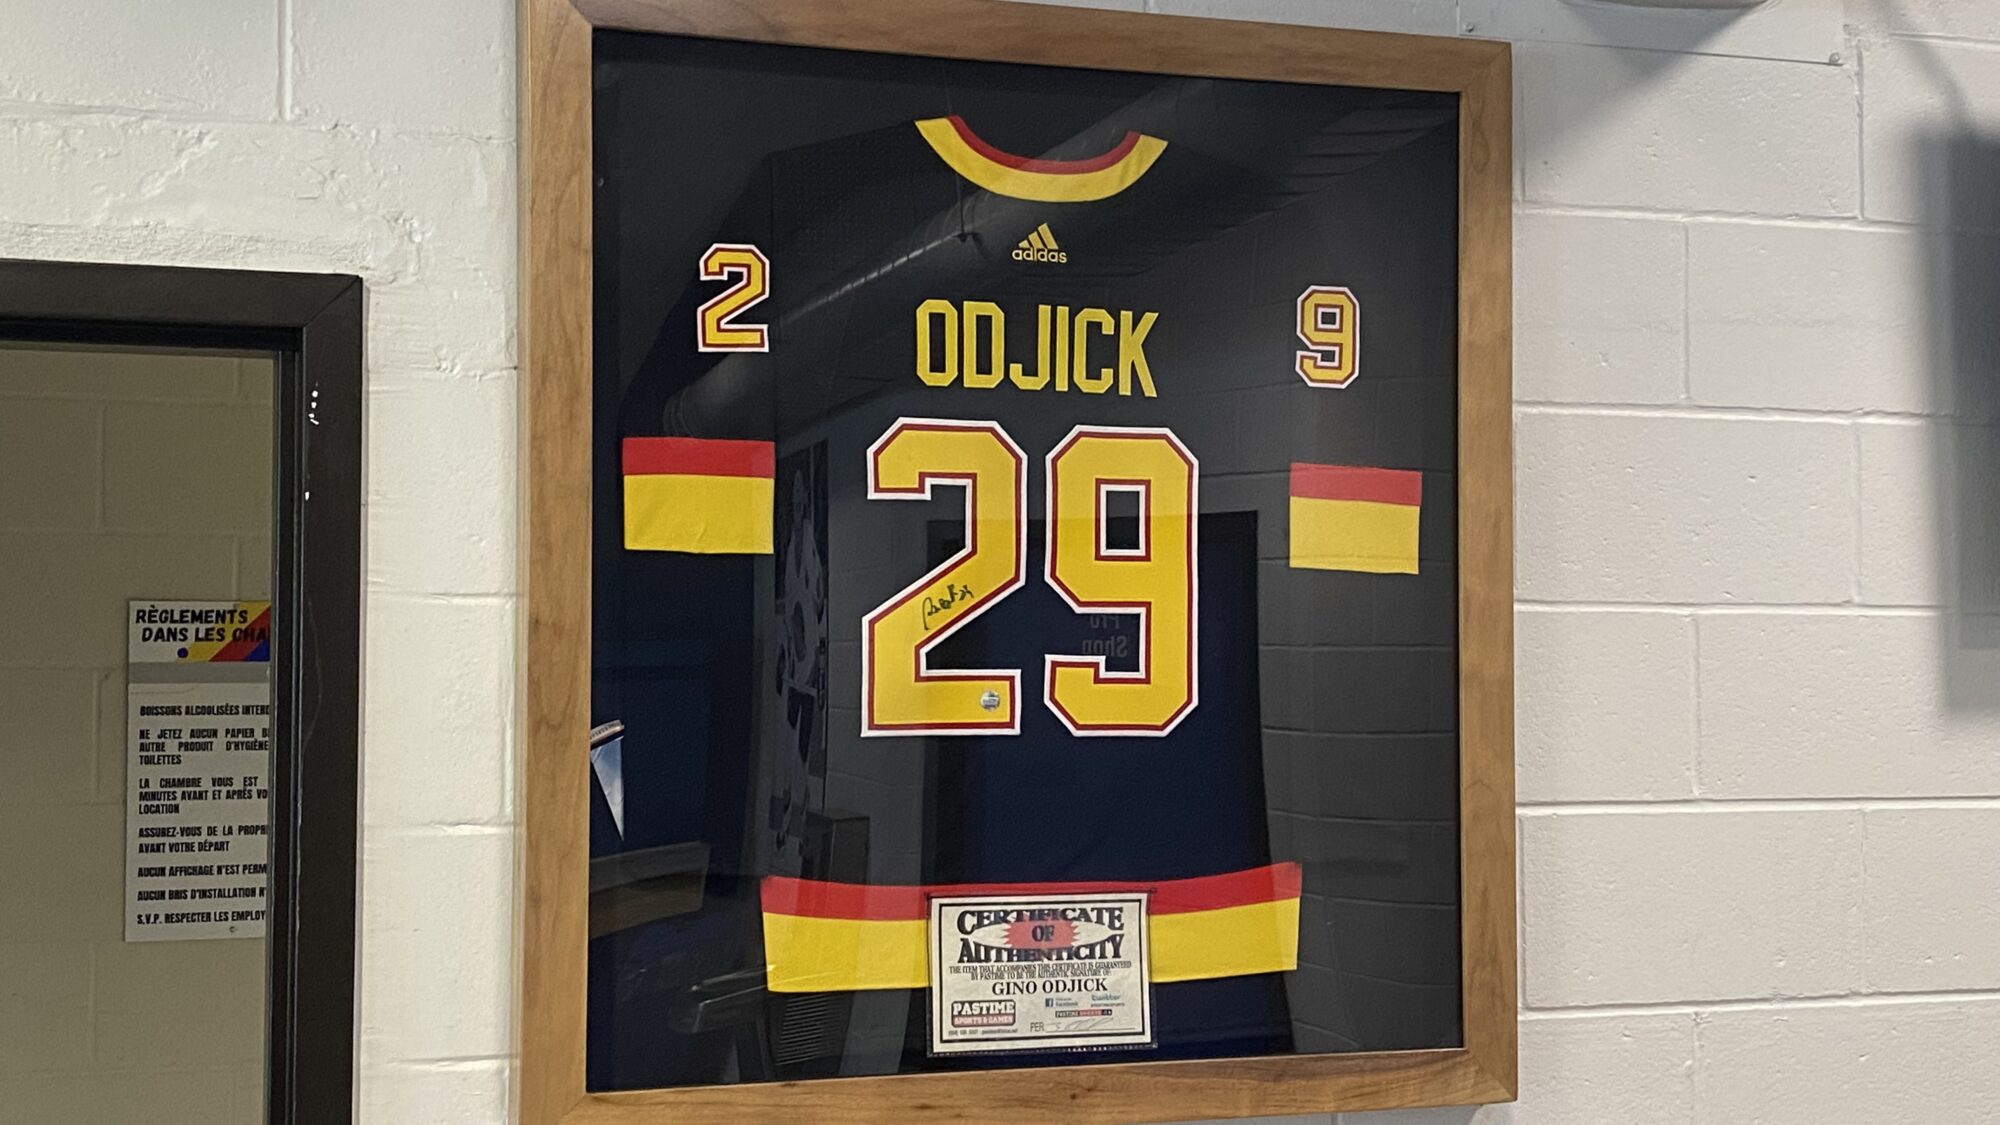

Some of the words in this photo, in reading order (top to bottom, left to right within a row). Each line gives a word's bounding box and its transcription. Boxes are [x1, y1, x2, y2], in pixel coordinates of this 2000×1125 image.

[1012, 247, 1068, 263] adidas
[697, 243, 770, 352] 2
[1295, 286, 1360, 389] 9
[916, 299, 1159, 398] ODJICK
[860, 417, 1198, 737] 29
[136, 605, 248, 624] RÈGLEMENTS
[142, 628, 188, 642] DANS
[195, 628, 225, 642] LES
[140, 706, 183, 716] BOISSONS
[184, 703, 239, 715] ALCOOLISÉES
[139, 729, 150, 740] NE
[157, 729, 182, 739] JETEZ
[190, 729, 218, 739] AUCUN
[225, 728, 254, 738] PAPIER
[139, 742, 165, 752] AUTRE
[178, 742, 214, 751] PRODUIT
[226, 739, 269, 751] D'HYGIÈNE
[139, 755, 182, 765] TOILETTES
[139, 779, 149, 789] LA
[160, 778, 202, 788] CHAMBRE
[212, 777, 234, 787] VOUS
[243, 776, 258, 786] EST
[139, 791, 177, 801] MINUTES
[181, 790, 208, 800] AVANT
[212, 790, 222, 800] ET
[139, 804, 180, 814] LOCATION
[139, 826, 202, 838] ASSUREZ-VOUS
[207, 826, 218, 836] DE
[223, 825, 233, 836] LA
[139, 842, 165, 853] AVANT
[169, 842, 195, 852] VOTRE
[198, 840, 230, 852] DÉPART
[138, 867, 166, 877] AUCUN
[168, 866, 214, 876] AFFICHAGE
[217, 865, 240, 876] N'EST
[137, 890, 165, 901] AUCUN
[168, 890, 188, 900] BRIS
[190, 887, 256, 899] D'INSTALLATION
[137, 914, 162, 924] S.V.P.
[164, 913, 211, 923] RESPECTER
[214, 912, 228, 922] LES
[957, 907, 1124, 935] CERTIFICATE
[1032, 925, 1054, 942] OF
[957, 934, 1124, 963] AUTHENTICITY
[992, 981, 1037, 995] GINO
[1042, 978, 1108, 993] ODJICK
[953, 1002, 1014, 1015] PASTIME
